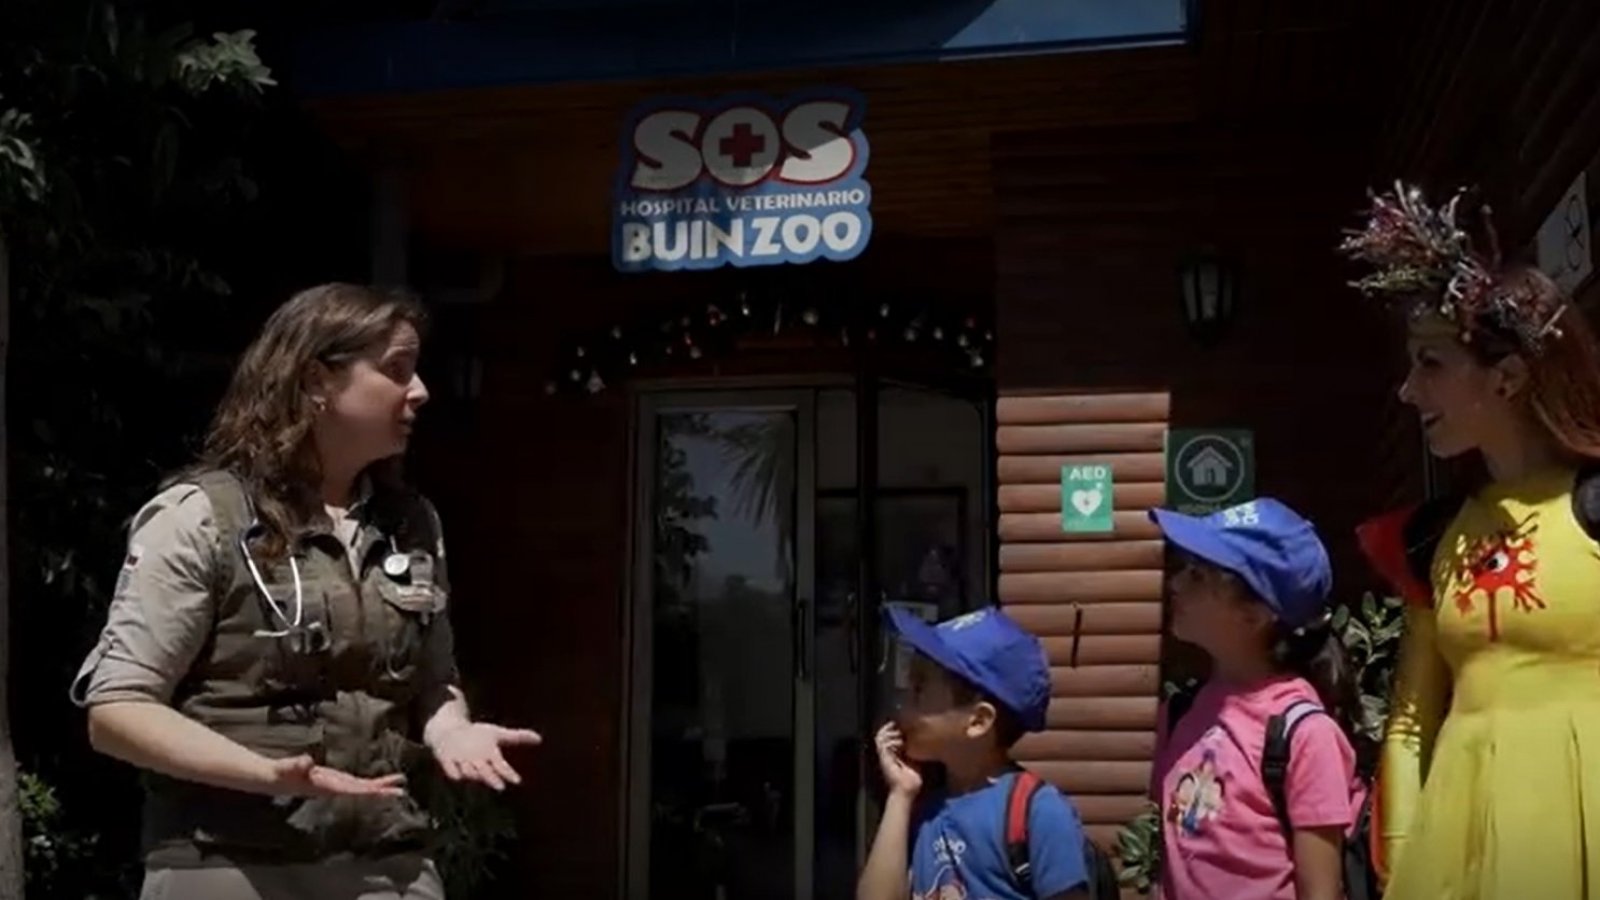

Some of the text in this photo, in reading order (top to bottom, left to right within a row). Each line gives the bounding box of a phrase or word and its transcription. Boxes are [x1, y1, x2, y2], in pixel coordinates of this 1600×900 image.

[631, 102, 855, 190] SOS
[621, 189, 865, 216] HOSPITAL VETERINARIO
[1070, 466, 1106, 481] AED
